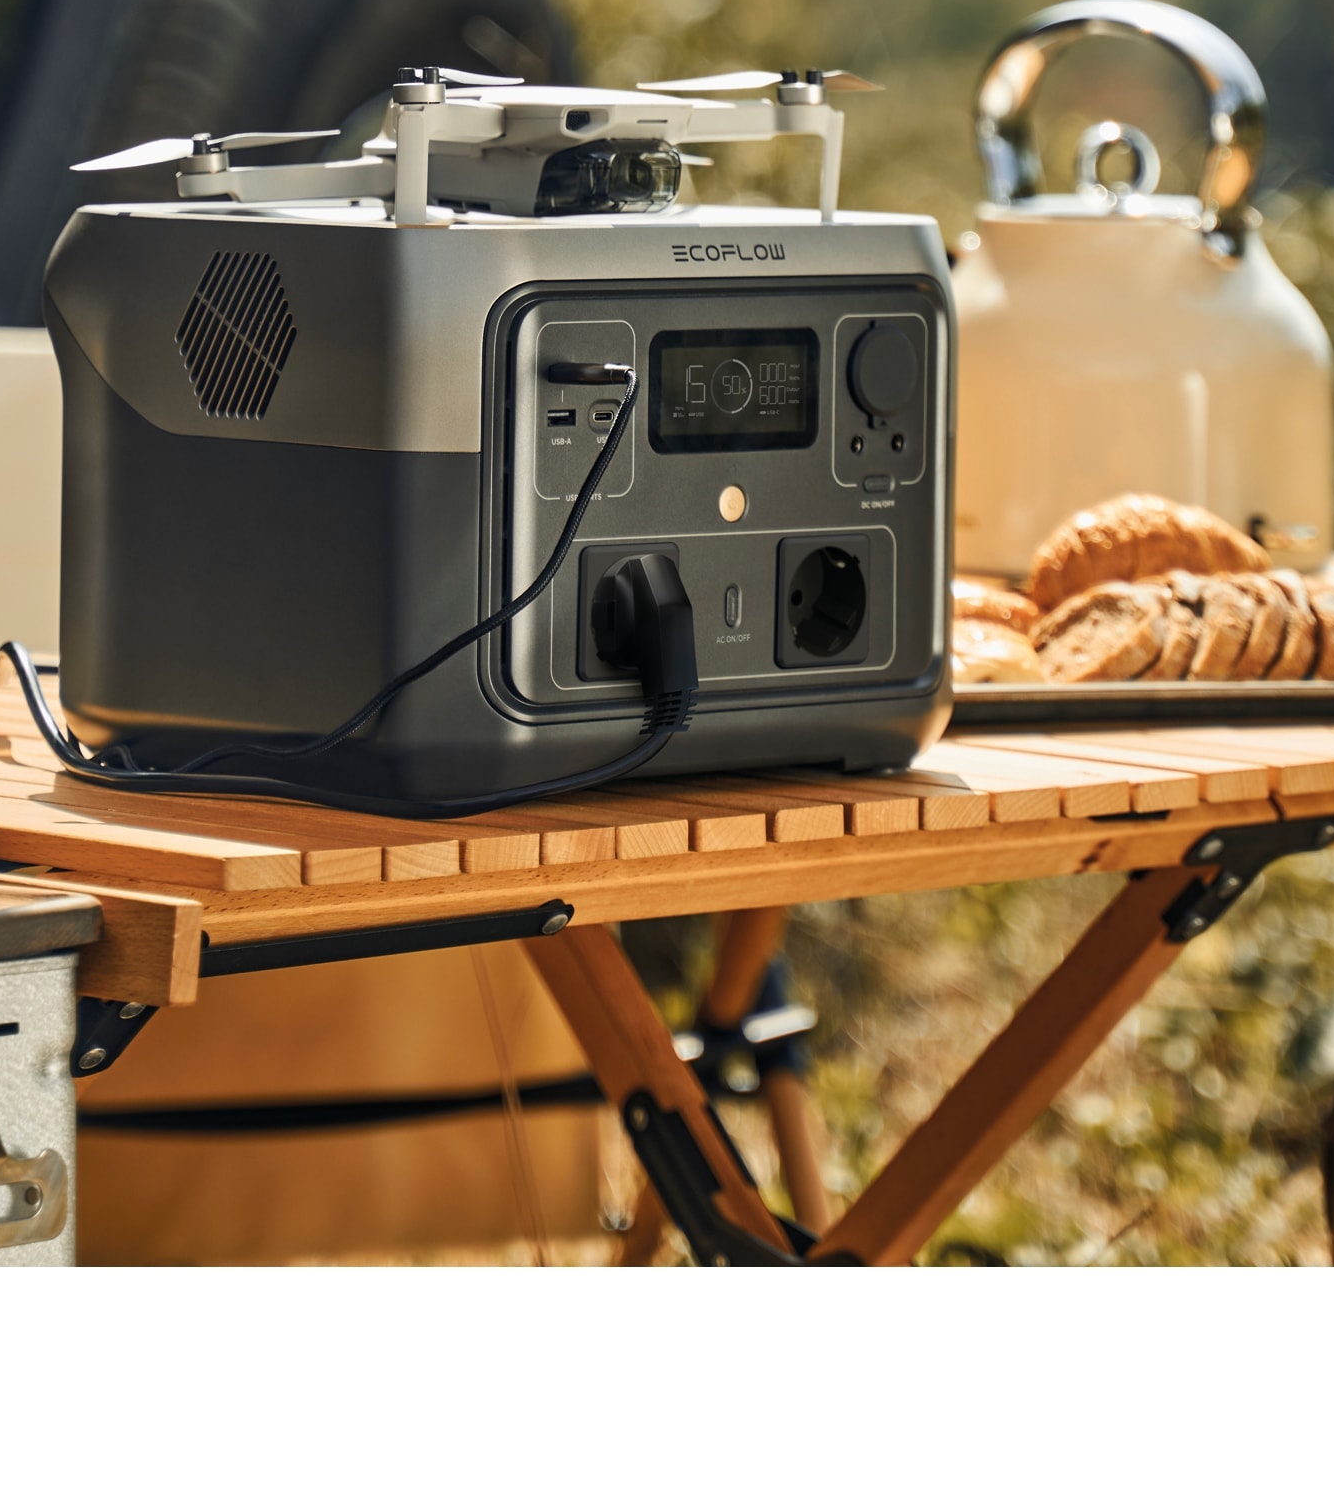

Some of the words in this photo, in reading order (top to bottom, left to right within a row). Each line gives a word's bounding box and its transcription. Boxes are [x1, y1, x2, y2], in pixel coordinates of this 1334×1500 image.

[671, 243, 786, 262] ECOFLOW
[759, 363, 787, 382] 000
[759, 385, 787, 405] 600
[551, 437, 572, 446] USB-A
[715, 635, 725, 644] AC
[726, 633, 751, 643] ON/OFF
